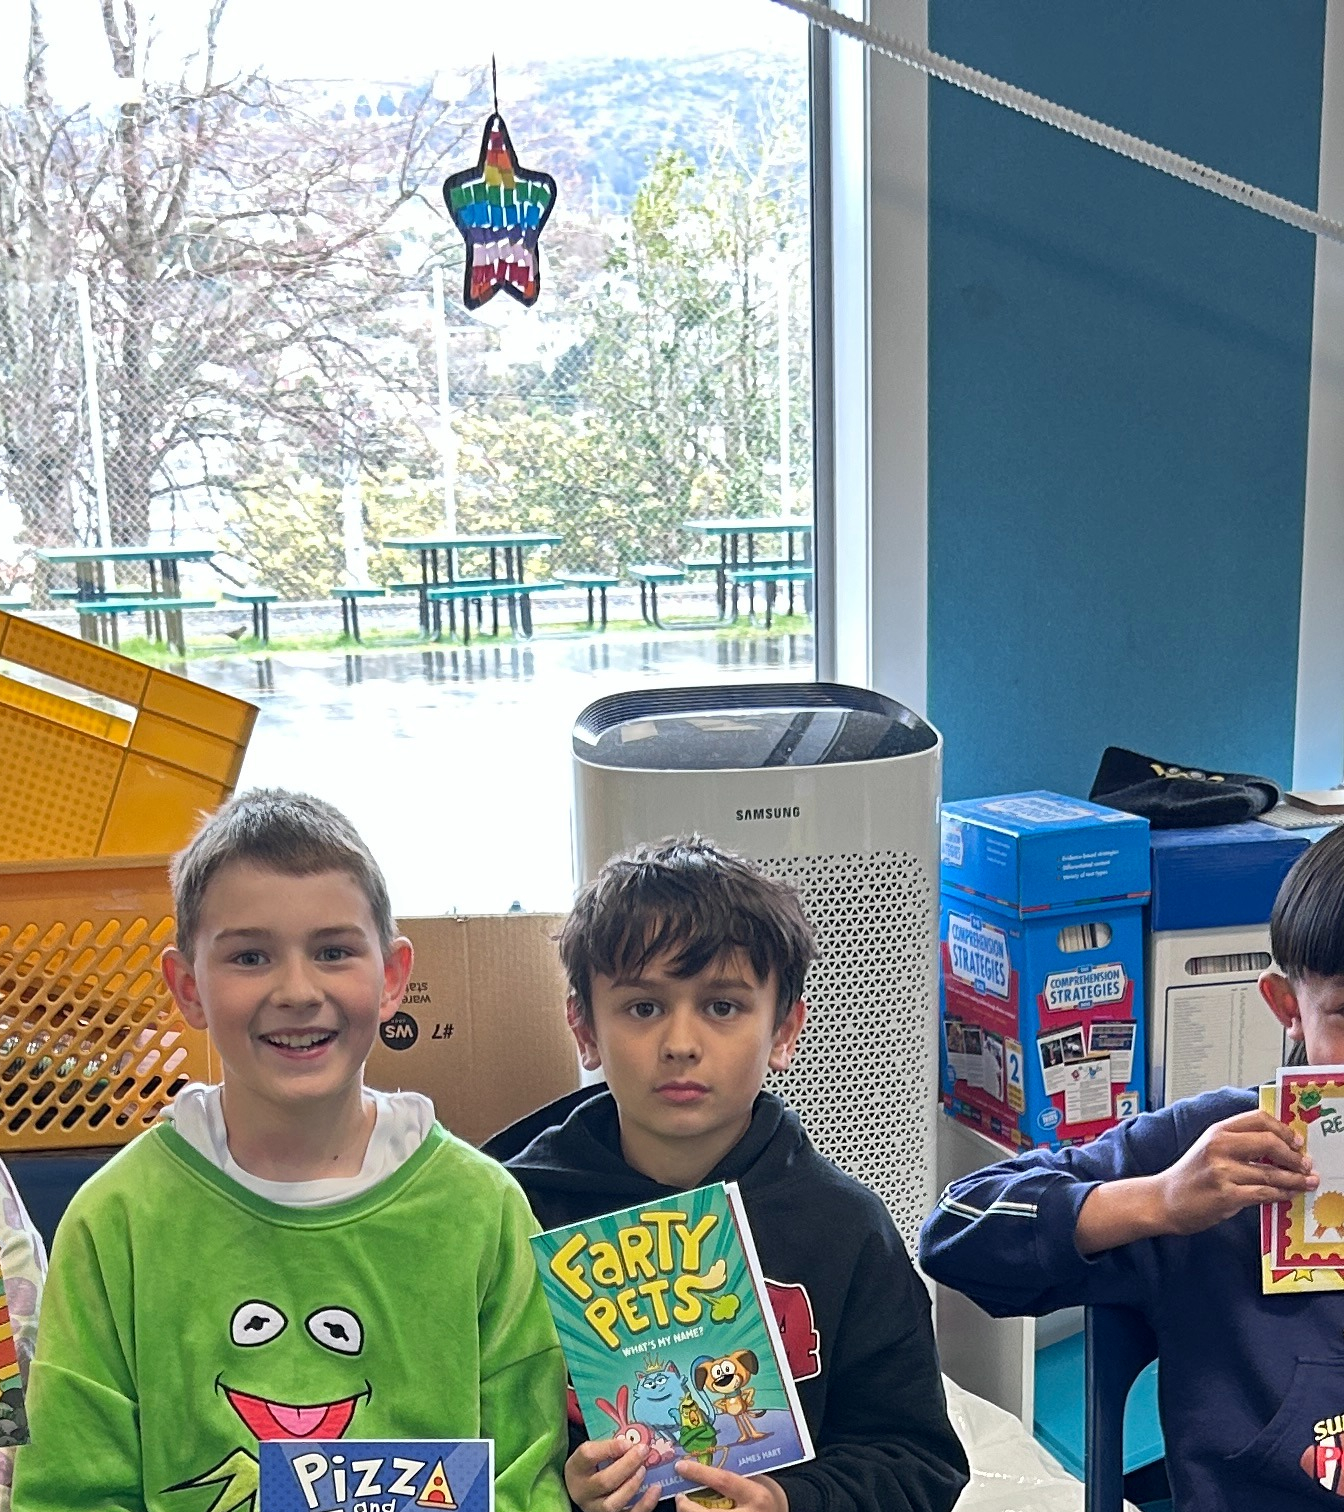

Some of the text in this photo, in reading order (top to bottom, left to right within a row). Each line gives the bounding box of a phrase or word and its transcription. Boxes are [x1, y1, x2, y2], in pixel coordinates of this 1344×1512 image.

[736, 806, 800, 820] SAMSUNG
[952, 923, 1004, 959] COMPREHENSION
[953, 943, 1006, 987] STRATEGIES
[1050, 969, 1119, 989] COMPREHENSION
[1050, 981, 1119, 1004] STRATEGIES
[385, 1024, 413, 1039] WS
[432, 1023, 454, 1039] #7
[1009, 1053, 1020, 1083] 2
[1121, 1101, 1132, 1116] 2
[583, 1270, 712, 1349] PETS
[622, 1326, 704, 1357] WHAT'S MY NAME?
[738, 1447, 782, 1467] JAMES HART
